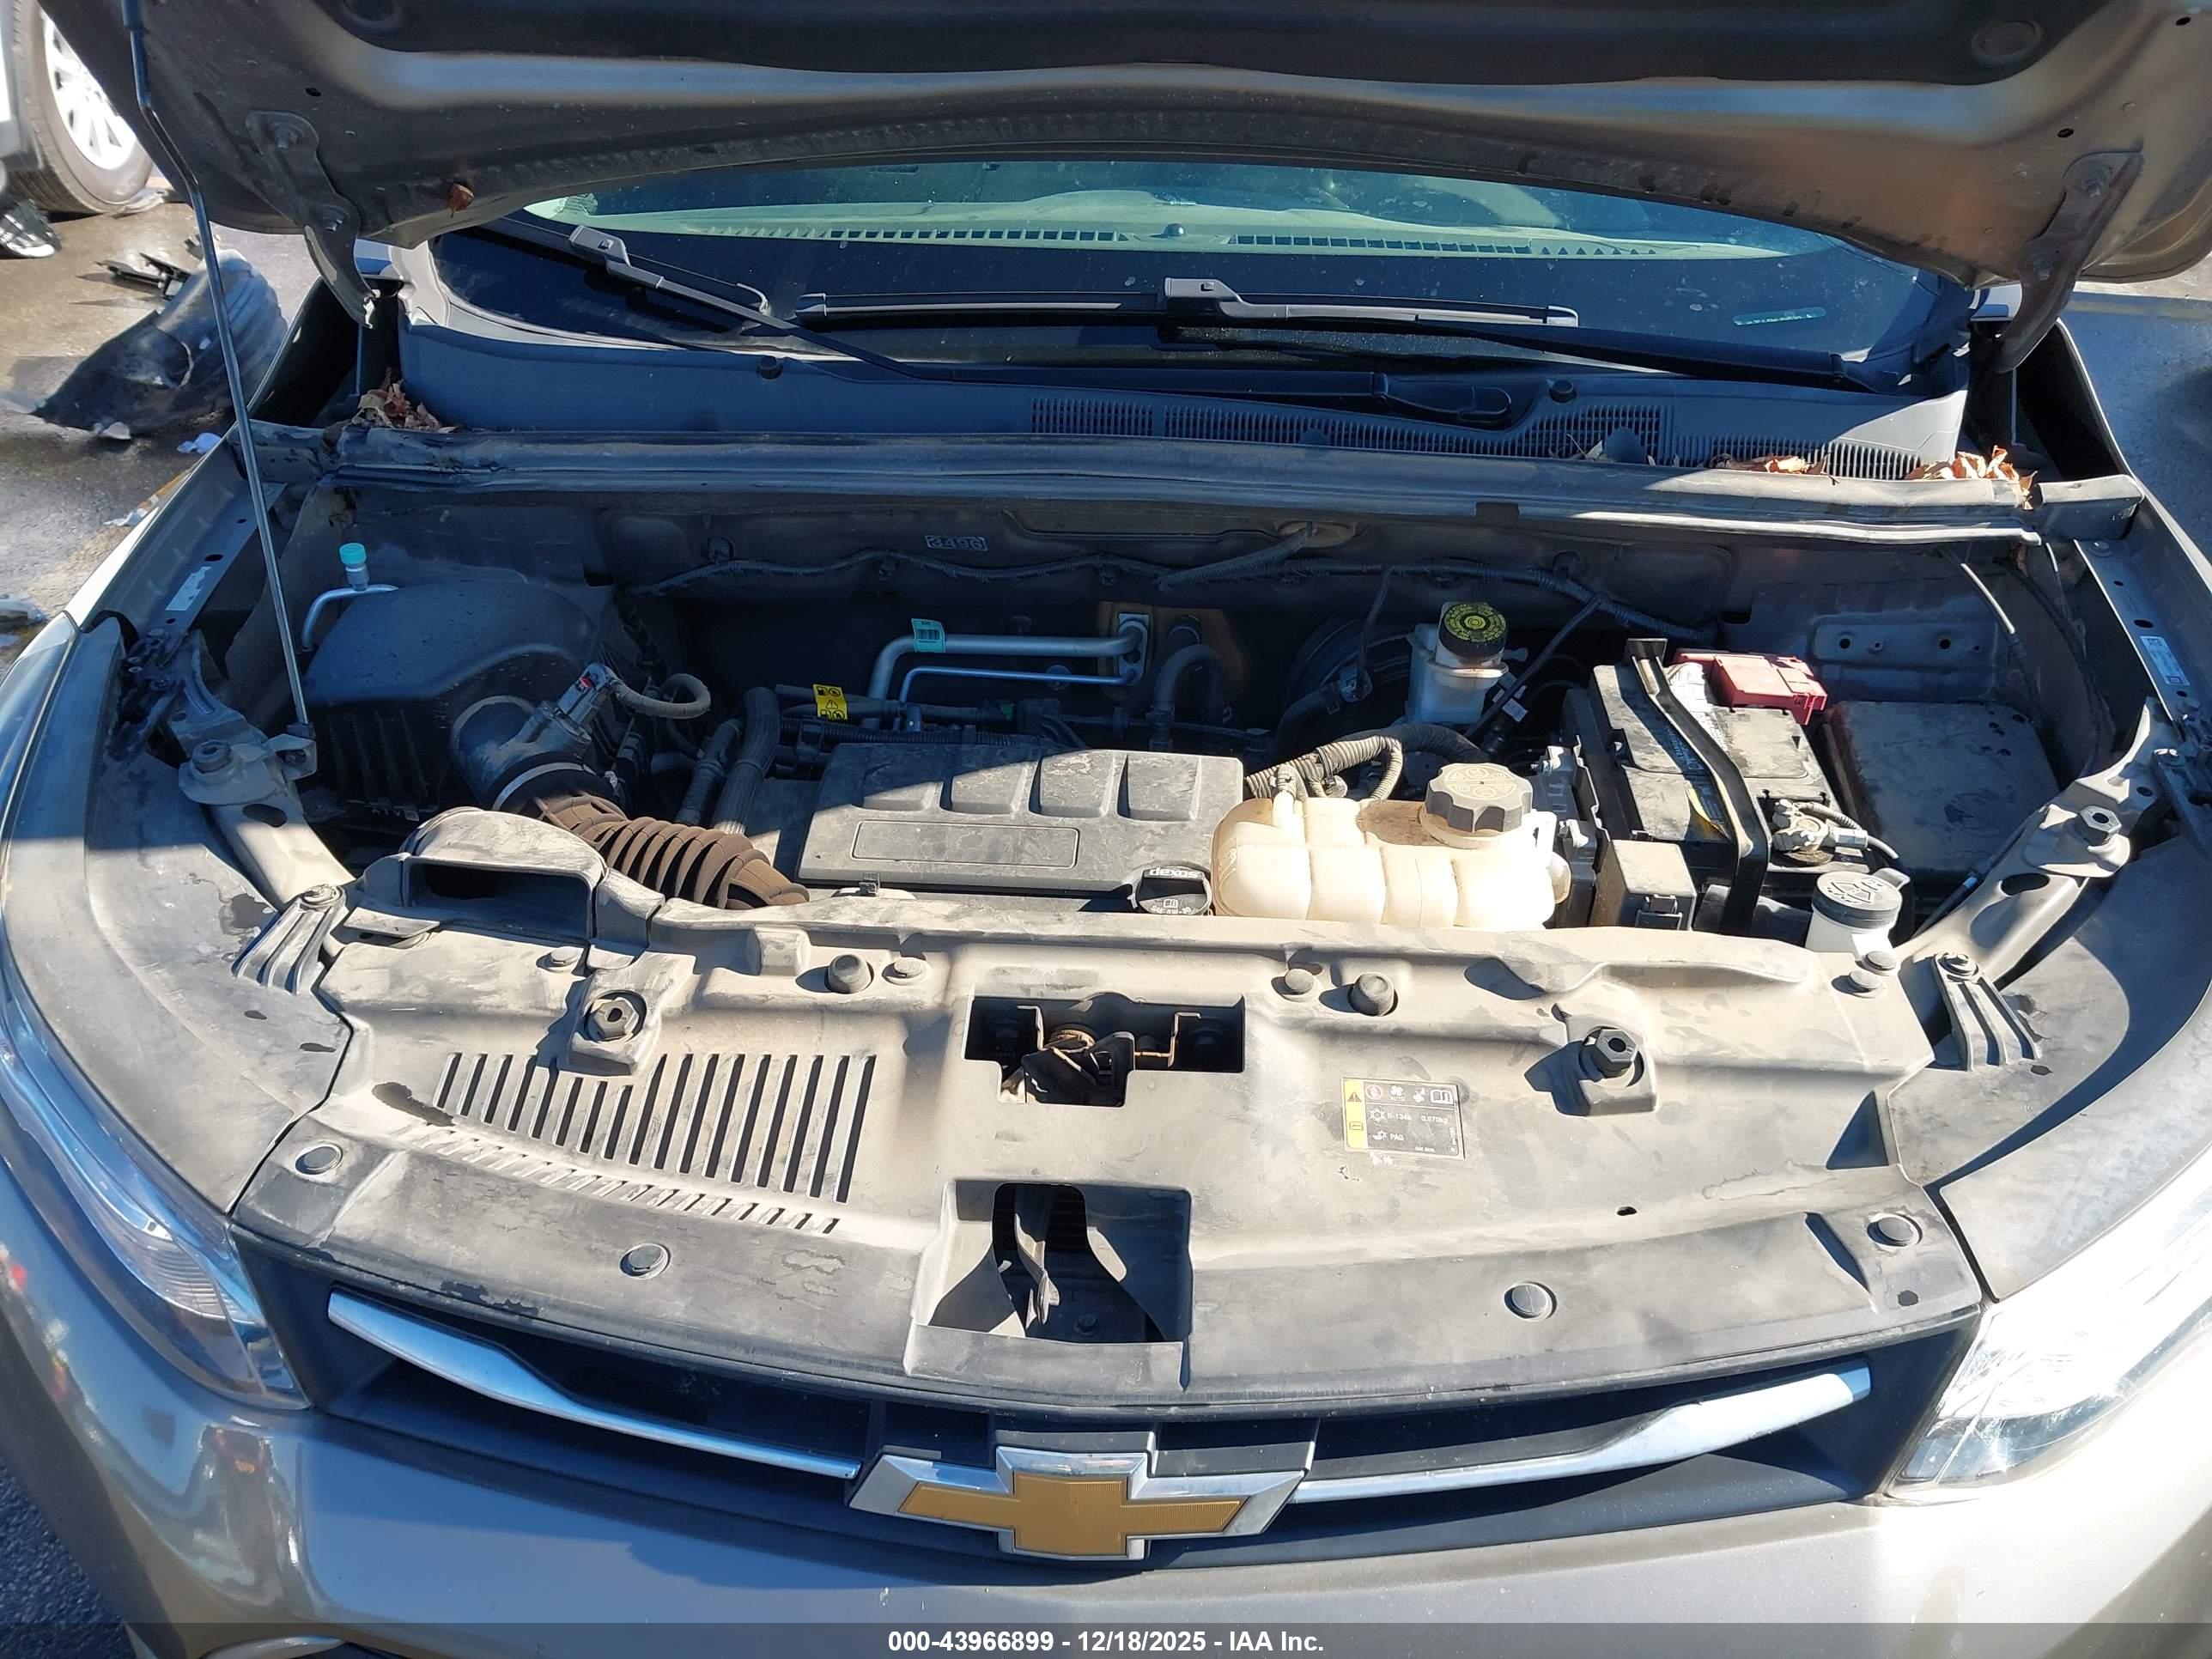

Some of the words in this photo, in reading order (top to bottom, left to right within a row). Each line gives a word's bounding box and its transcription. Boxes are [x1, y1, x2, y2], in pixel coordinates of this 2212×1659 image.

[928, 538, 982, 550] 3496
[1149, 867, 1198, 878] dexos
[1151, 905, 1165, 914] SAE
[1420, 1115, 1449, 1125] 0.570kg
[1389, 1133, 1405, 1141] PAG
